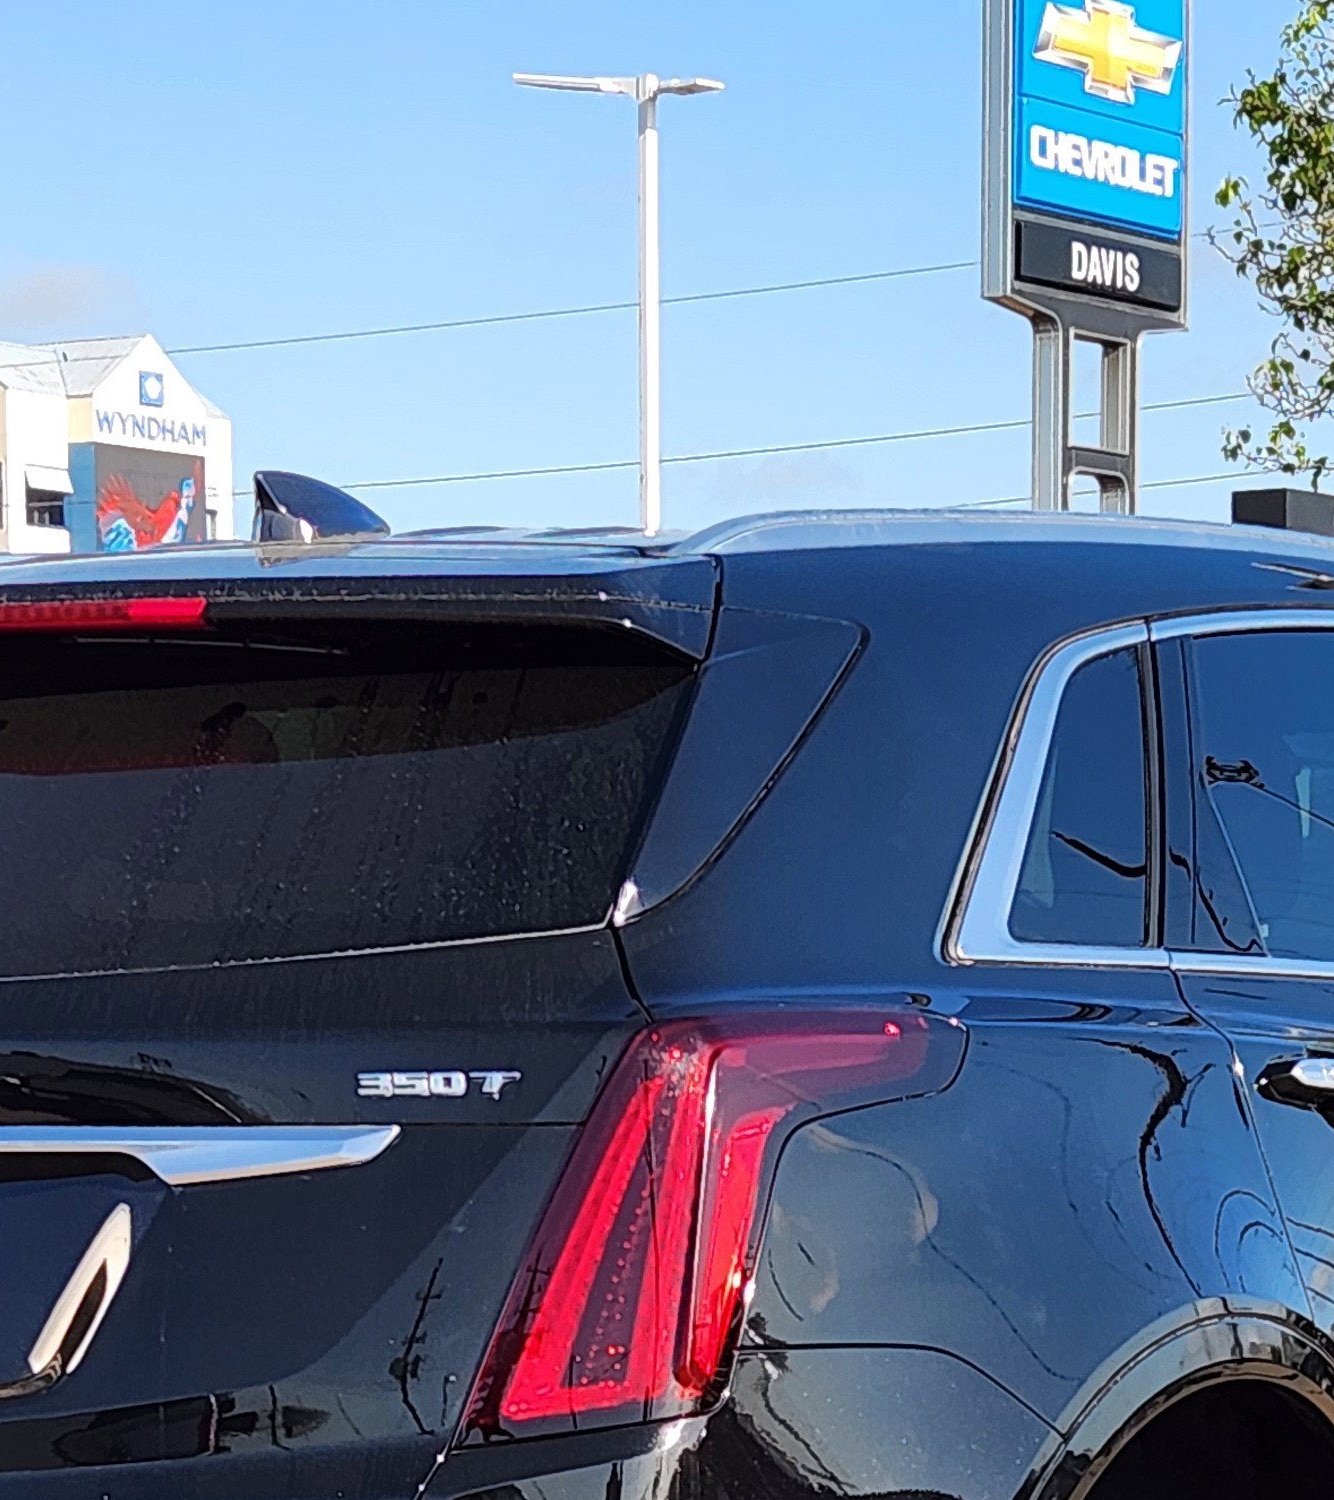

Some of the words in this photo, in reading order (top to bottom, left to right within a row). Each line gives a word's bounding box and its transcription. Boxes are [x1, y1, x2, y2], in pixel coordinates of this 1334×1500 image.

[1030, 124, 1178, 198] CHEVROLET
[1071, 241, 1140, 292] DAVIS
[95, 409, 207, 447] WYNDHAM
[357, 1071, 522, 1101] 350T
